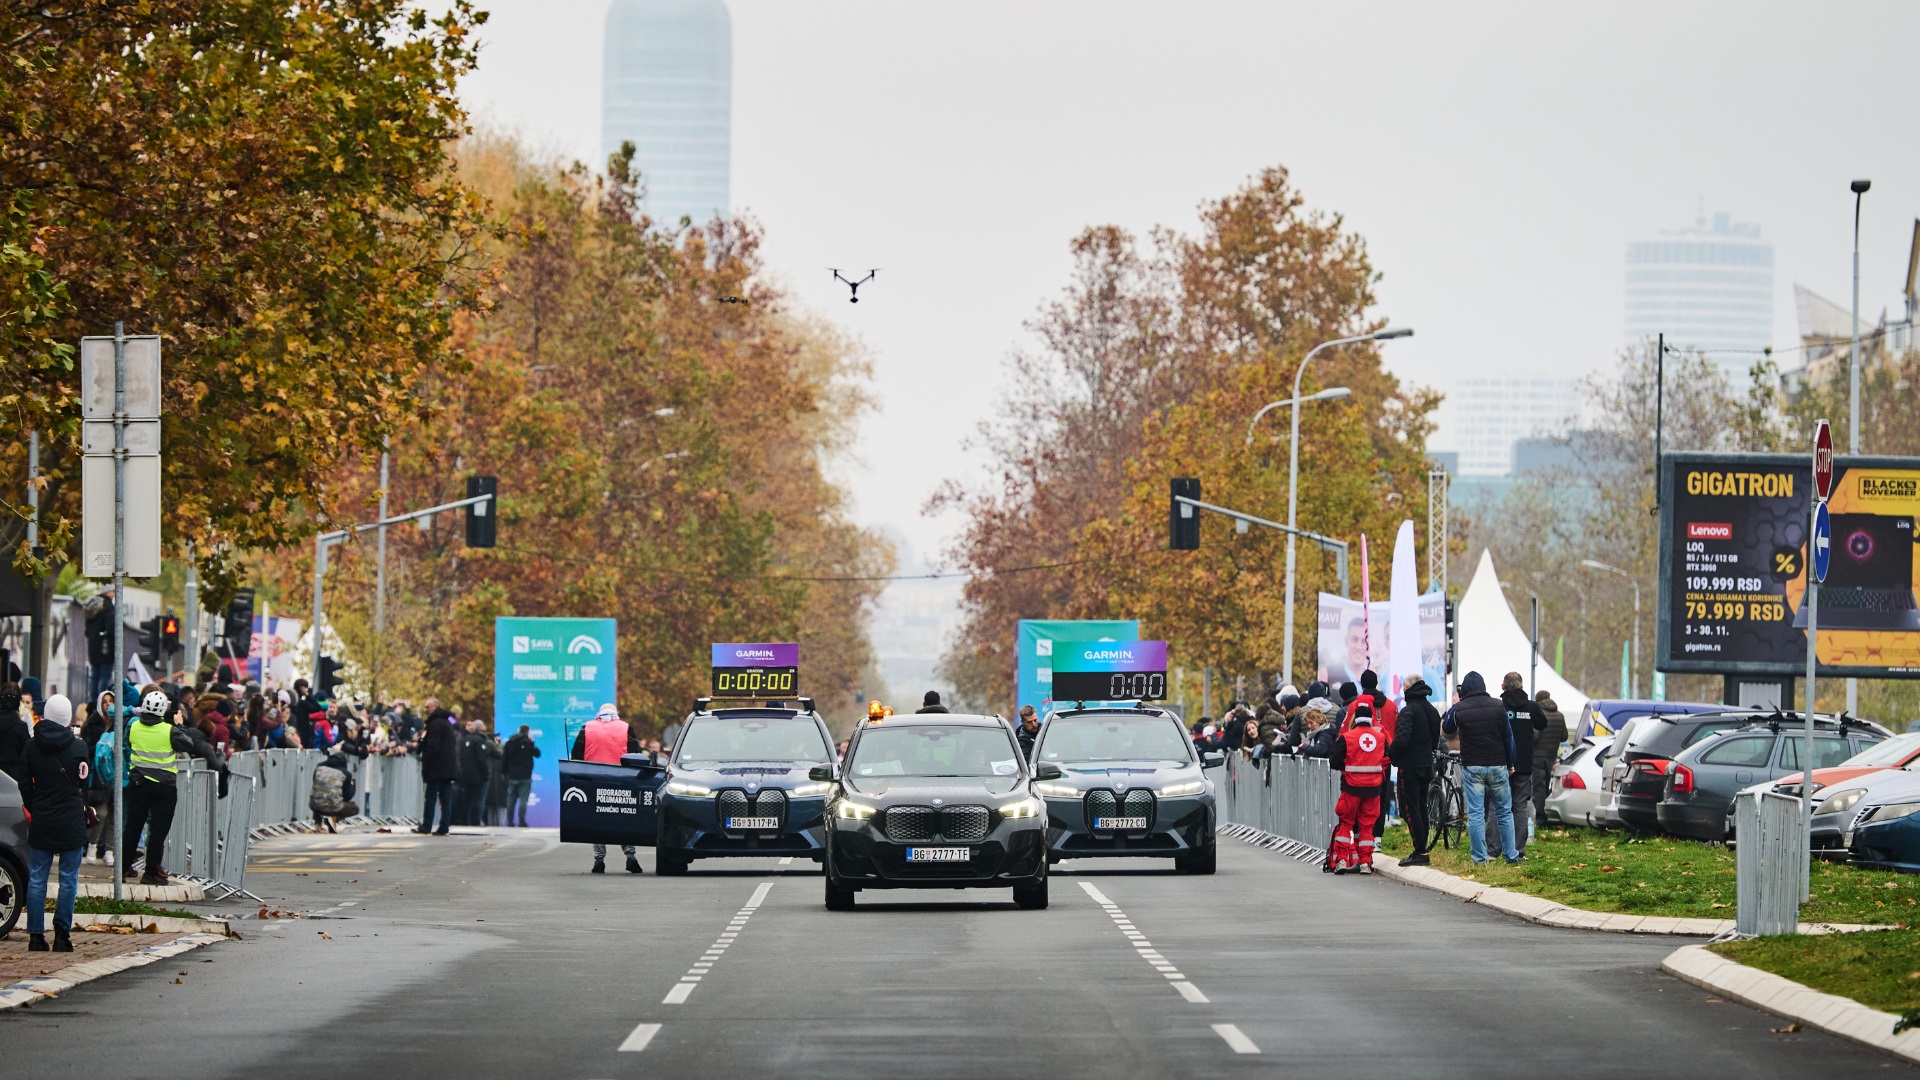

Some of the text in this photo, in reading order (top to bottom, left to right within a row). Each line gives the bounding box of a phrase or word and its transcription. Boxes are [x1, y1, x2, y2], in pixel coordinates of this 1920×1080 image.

[1817, 448, 1831, 473] STOP
[1687, 472, 1794, 497] GIGATRON
[1863, 488, 1916, 496] NOVEMBER
[1690, 524, 1729, 536] Lenovo
[1686, 542, 1704, 553] LOQ
[1686, 576, 1762, 591] 109.999 RSD
[1705, 593, 1714, 601] ZA
[1716, 594, 1747, 602] GIGAMAX
[1748, 594, 1784, 602] KORISNIKE
[1686, 602, 1785, 621] 79.999 RSD
[1686, 624, 1692, 635] 3
[531, 639, 554, 648] SAVA
[1685, 642, 1722, 652] gigatron.rs
[719, 674, 791, 690] 0:00:00
[1110, 674, 1164, 698] 0:00
[596, 788, 632, 797] BEOGRADSKI
[596, 796, 637, 805] POLUMARATON
[732, 819, 741, 827] BG
[1101, 819, 1109, 827] BG
[914, 850, 925, 860] BG
